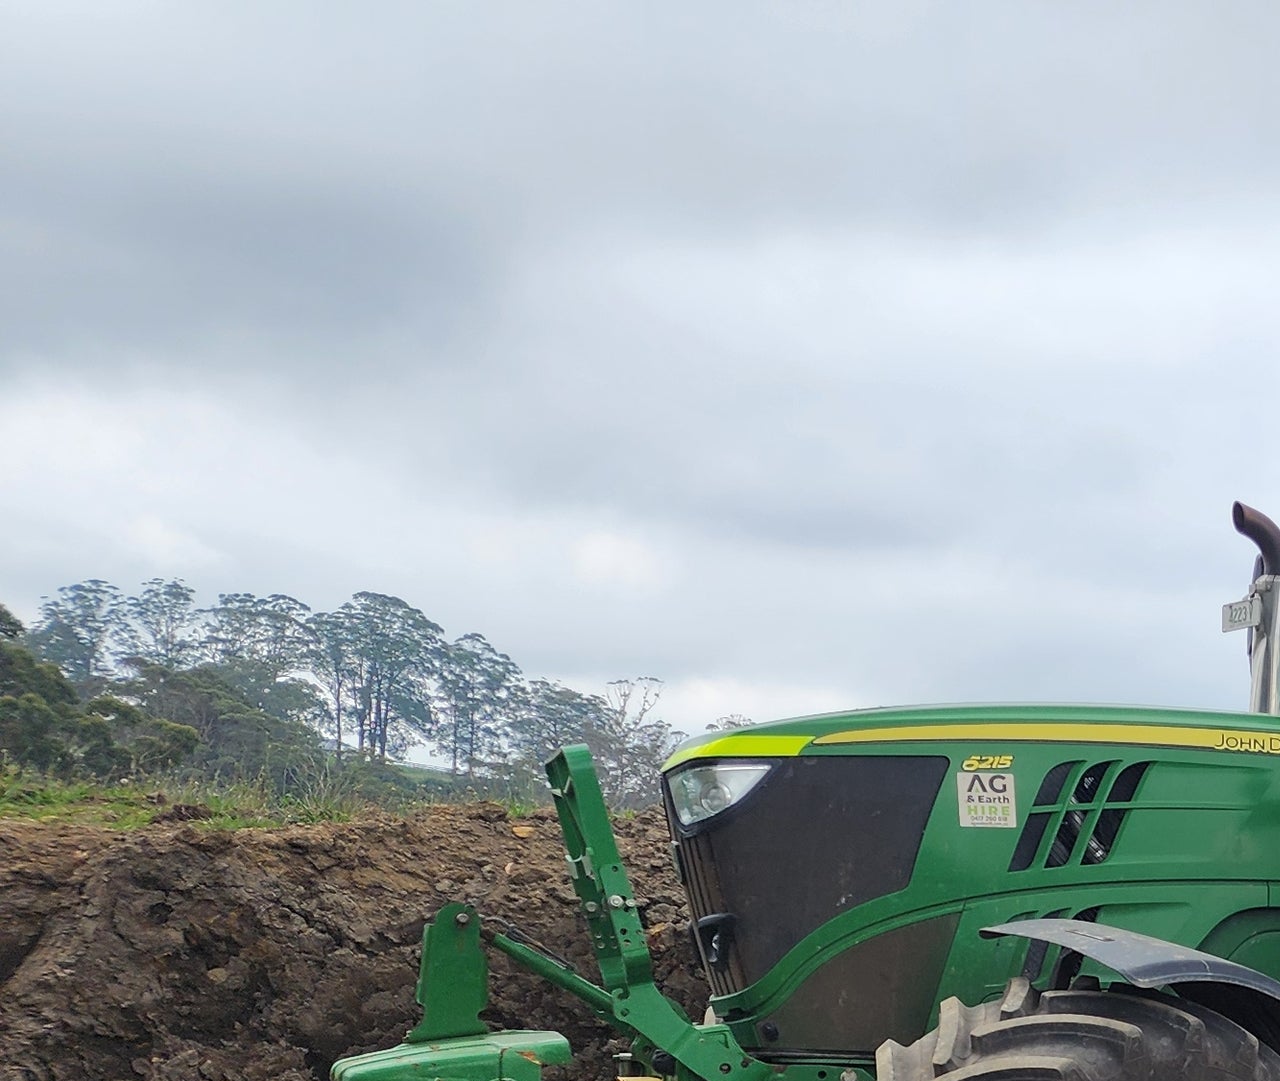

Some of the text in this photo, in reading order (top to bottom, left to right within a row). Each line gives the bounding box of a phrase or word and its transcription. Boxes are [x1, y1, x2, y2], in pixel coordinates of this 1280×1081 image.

[1215, 733, 1265, 751] JOHN
[962, 755, 1014, 771] 6215
[967, 774, 1007, 793] AG
[967, 795, 1010, 804] & Earth
[967, 805, 1010, 816] HIRE
